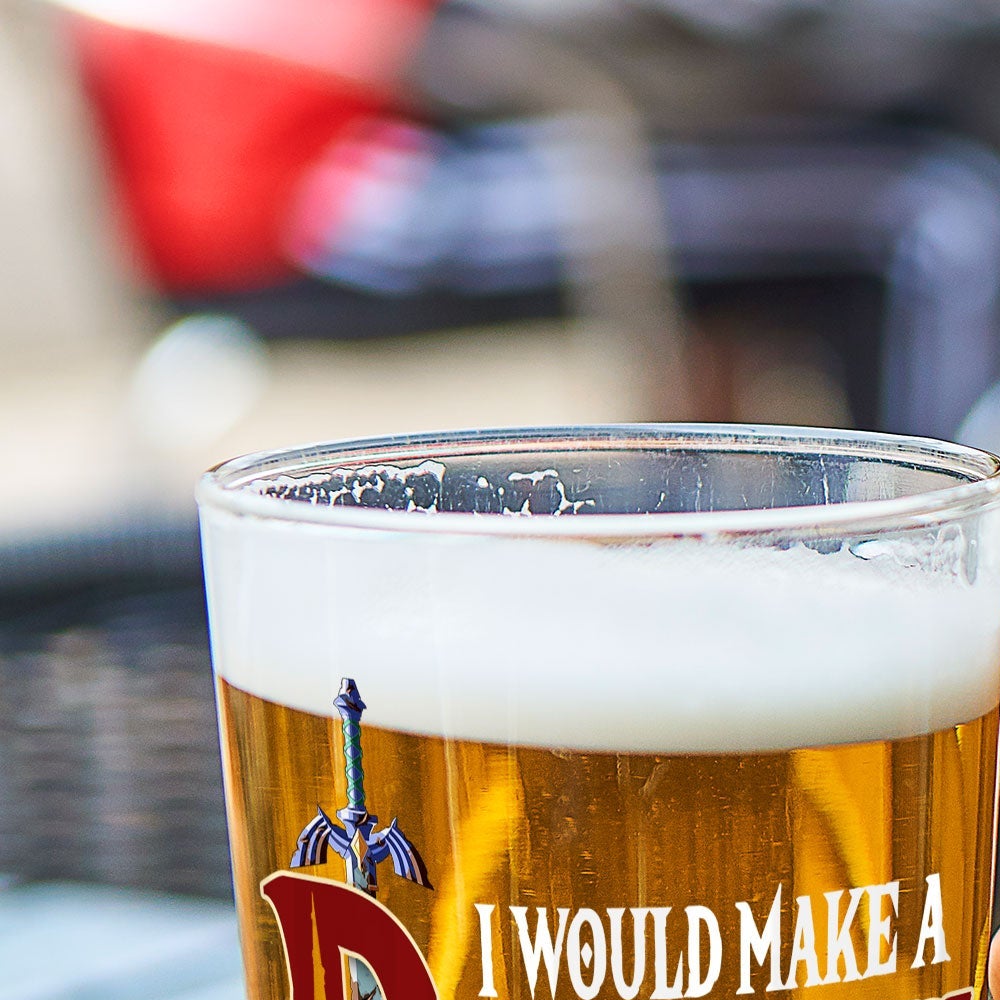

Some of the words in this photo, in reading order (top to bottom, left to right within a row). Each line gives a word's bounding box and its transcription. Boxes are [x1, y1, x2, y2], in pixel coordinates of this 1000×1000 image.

[475, 903, 498, 998] I
[736, 881, 901, 996] MAKE
[911, 873, 951, 970] A
